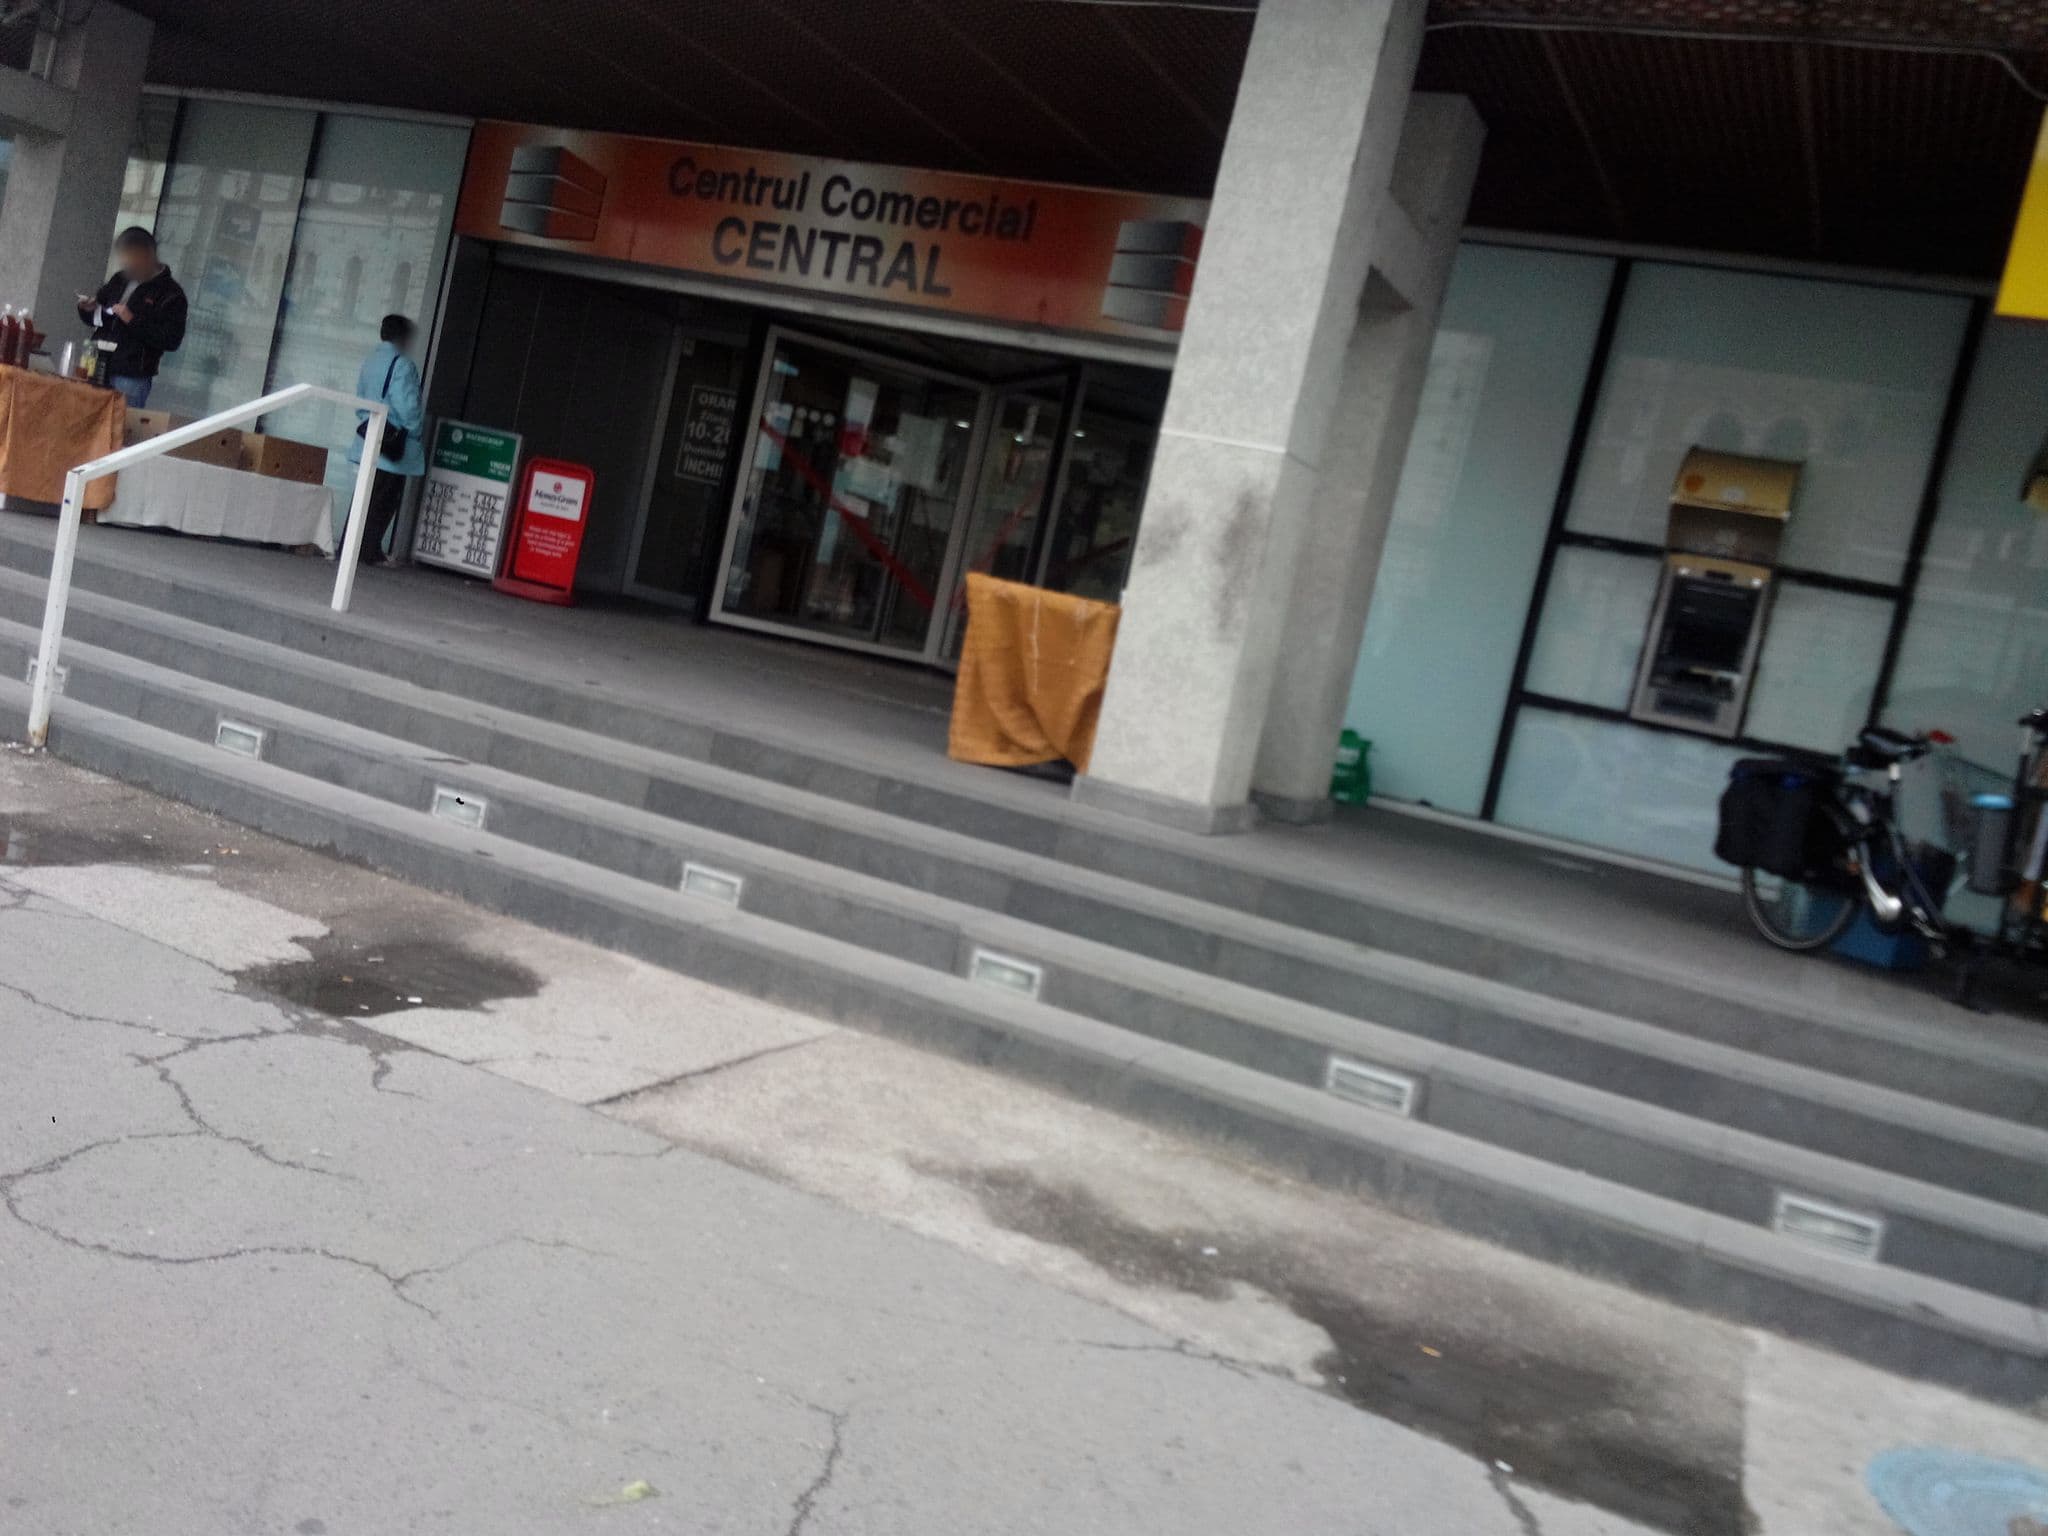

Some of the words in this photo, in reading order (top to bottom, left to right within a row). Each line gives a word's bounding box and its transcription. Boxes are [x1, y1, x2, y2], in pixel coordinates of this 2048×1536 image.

[668, 155, 810, 212] Centrul
[820, 174, 1037, 242] Comercial
[710, 216, 952, 297] CENTRAL
